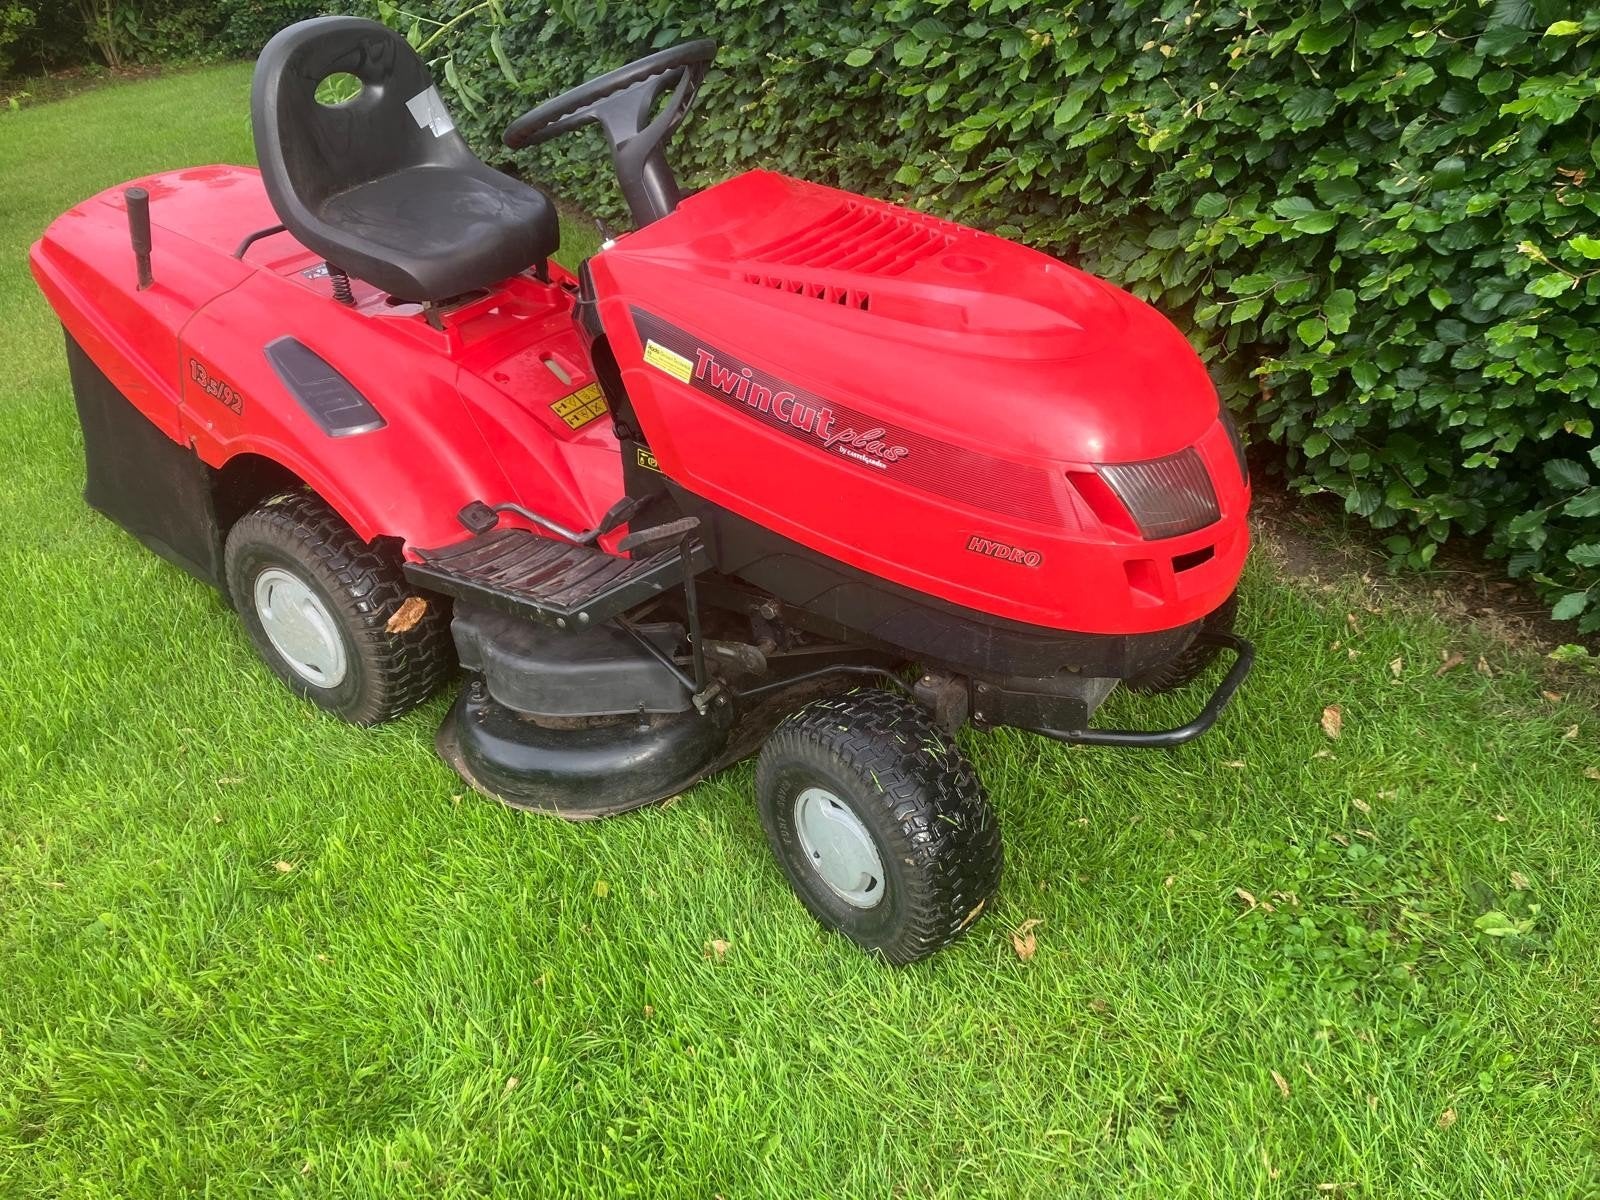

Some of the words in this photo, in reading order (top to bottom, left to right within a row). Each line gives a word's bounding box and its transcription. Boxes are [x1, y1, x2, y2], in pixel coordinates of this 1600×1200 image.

[695, 347, 835, 441] TwinCut
[824, 428, 909, 461] plus
[967, 535, 1042, 567] HYDRO
